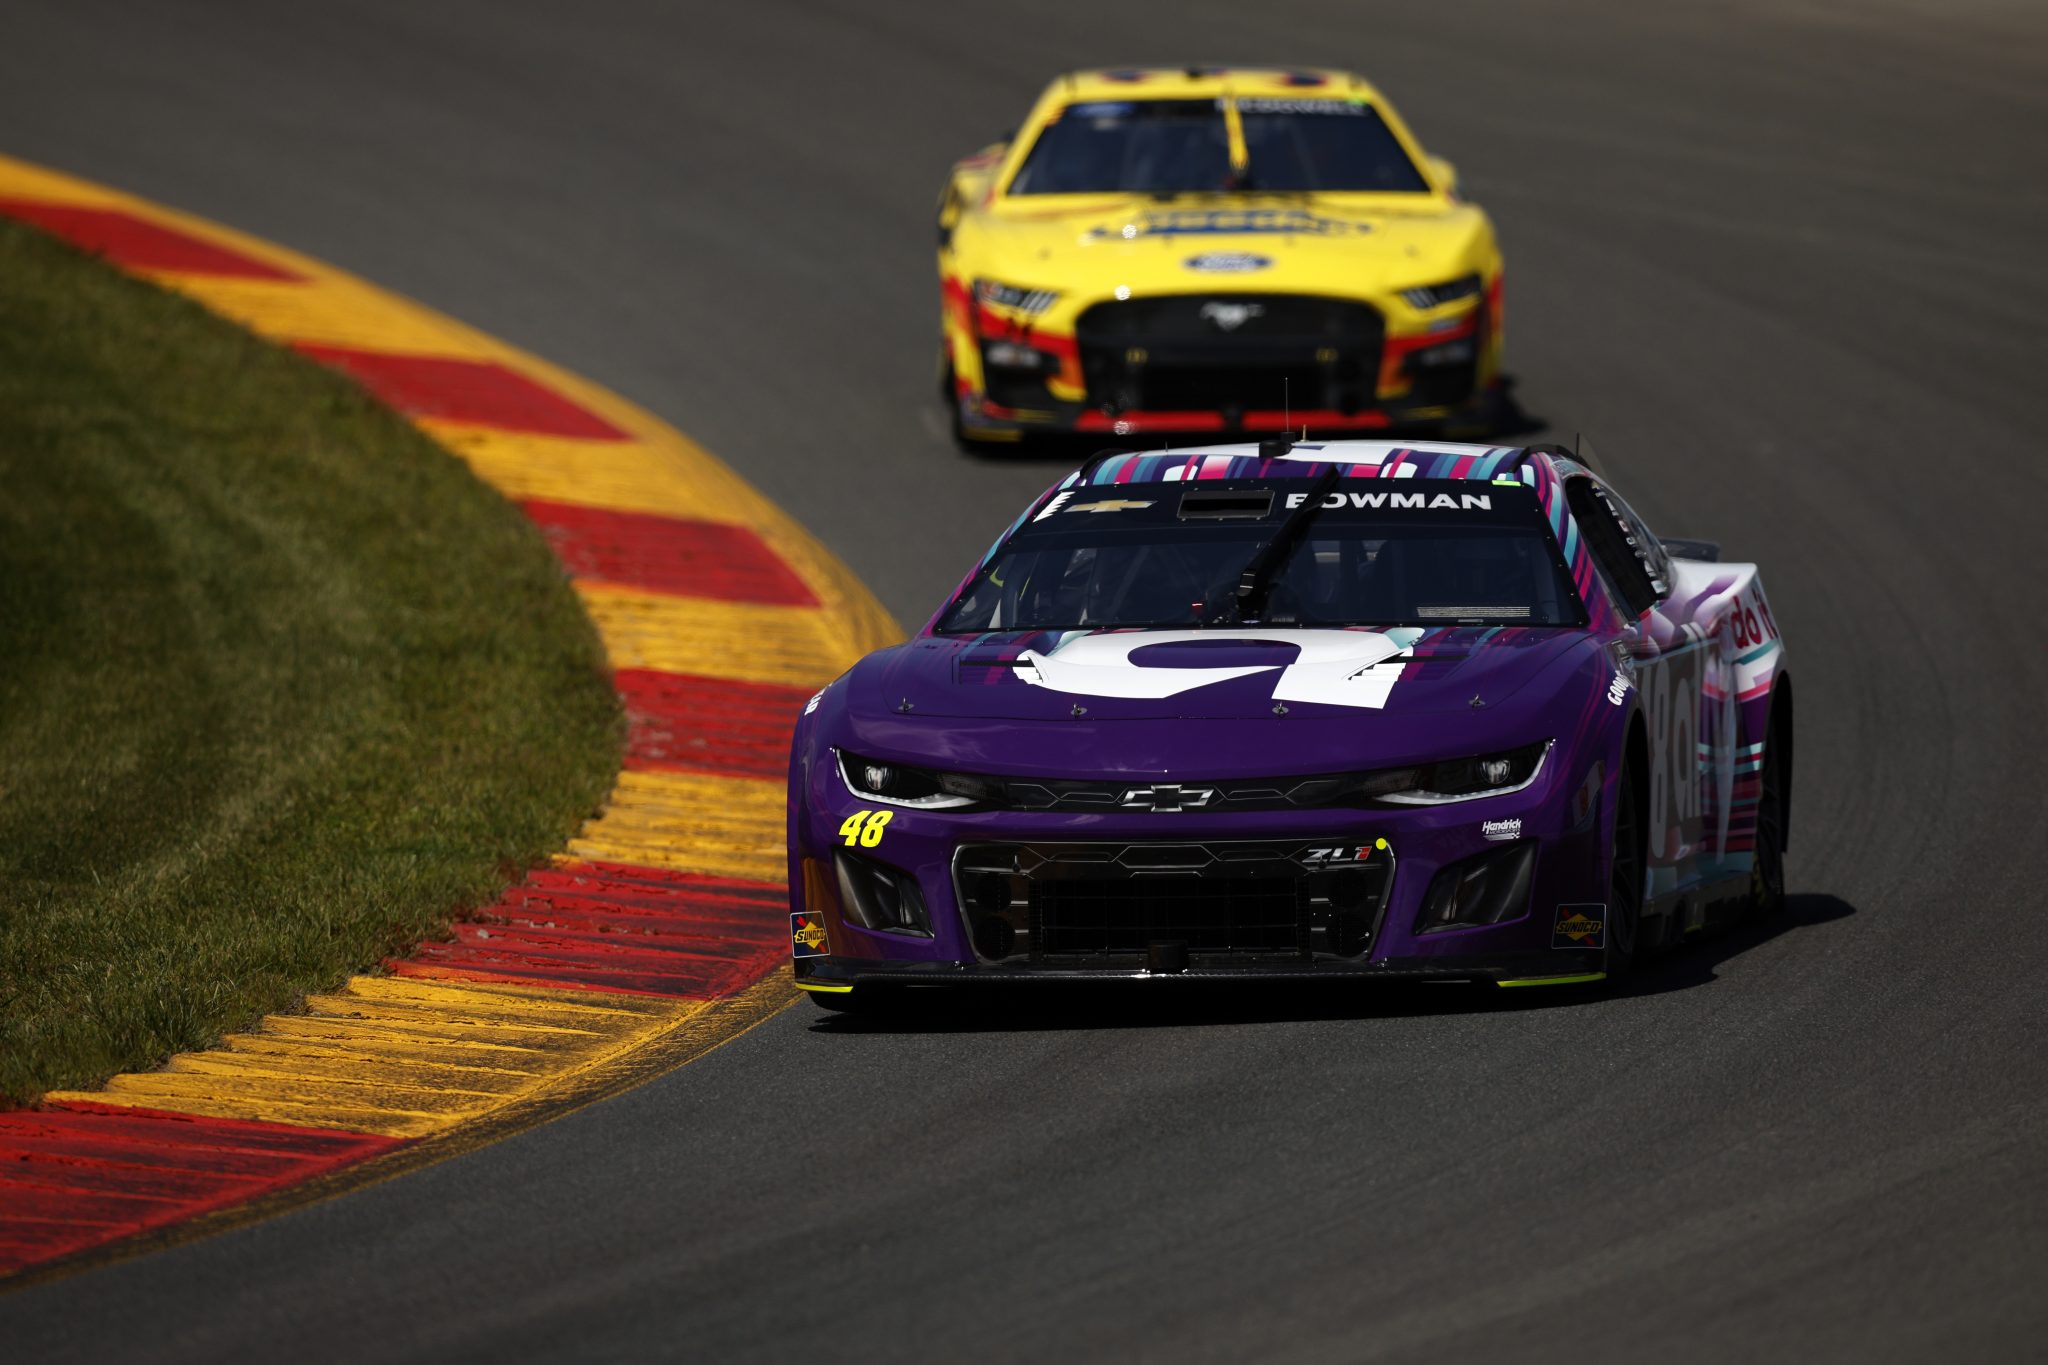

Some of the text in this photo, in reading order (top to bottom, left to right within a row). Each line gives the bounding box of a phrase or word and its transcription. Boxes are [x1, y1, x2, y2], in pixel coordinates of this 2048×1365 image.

[1285, 493, 1491, 510] BOWMAN
[839, 810, 894, 847] 48
[1482, 818, 1522, 834] Hendrick
[1302, 845, 1372, 862] ZL1
[1557, 920, 1602, 934] SUNOCO
[795, 928, 825, 943] SUNOCO
